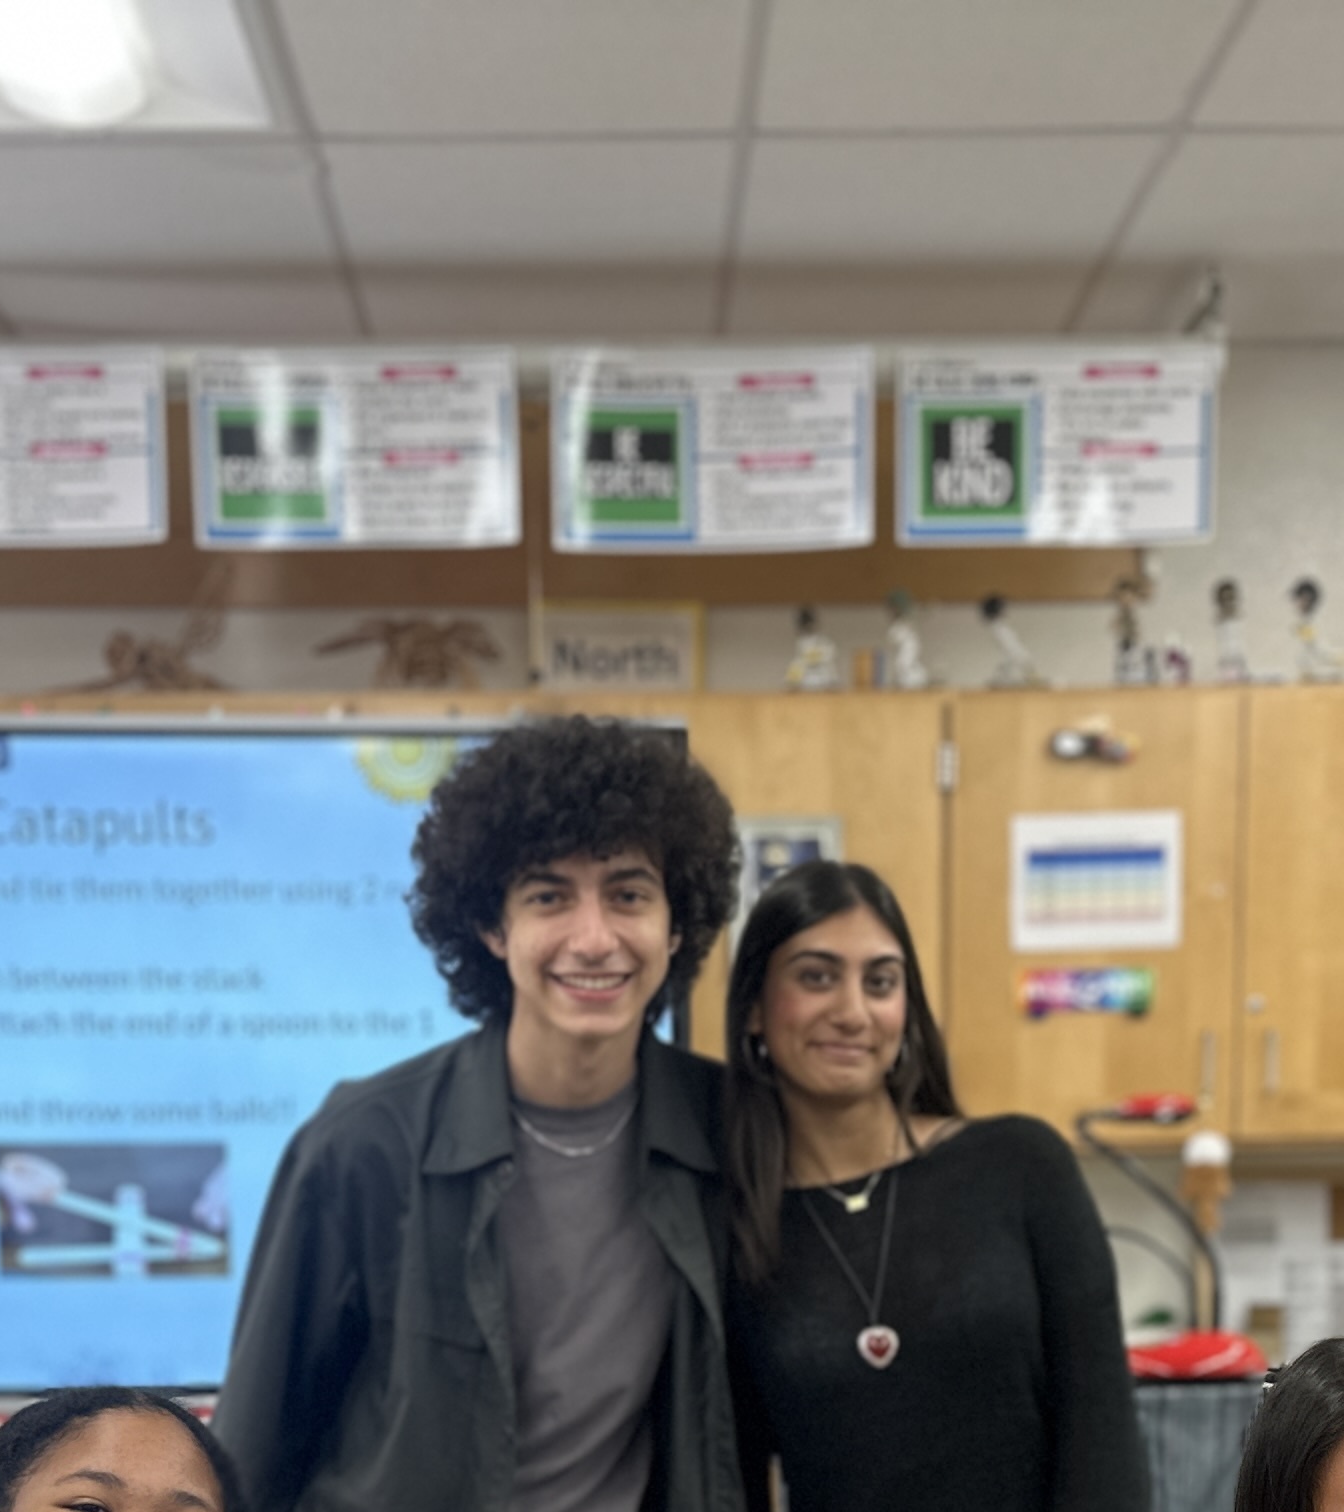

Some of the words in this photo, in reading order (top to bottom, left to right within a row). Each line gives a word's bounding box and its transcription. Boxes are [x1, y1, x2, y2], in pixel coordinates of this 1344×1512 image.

[951, 415, 994, 456] BE
[553, 637, 680, 682] North
[69, 870, 144, 903] them
[151, 872, 273, 907] together
[137, 960, 185, 994] the
[70, 1006, 115, 1040] the
[364, 1006, 413, 1040] the
